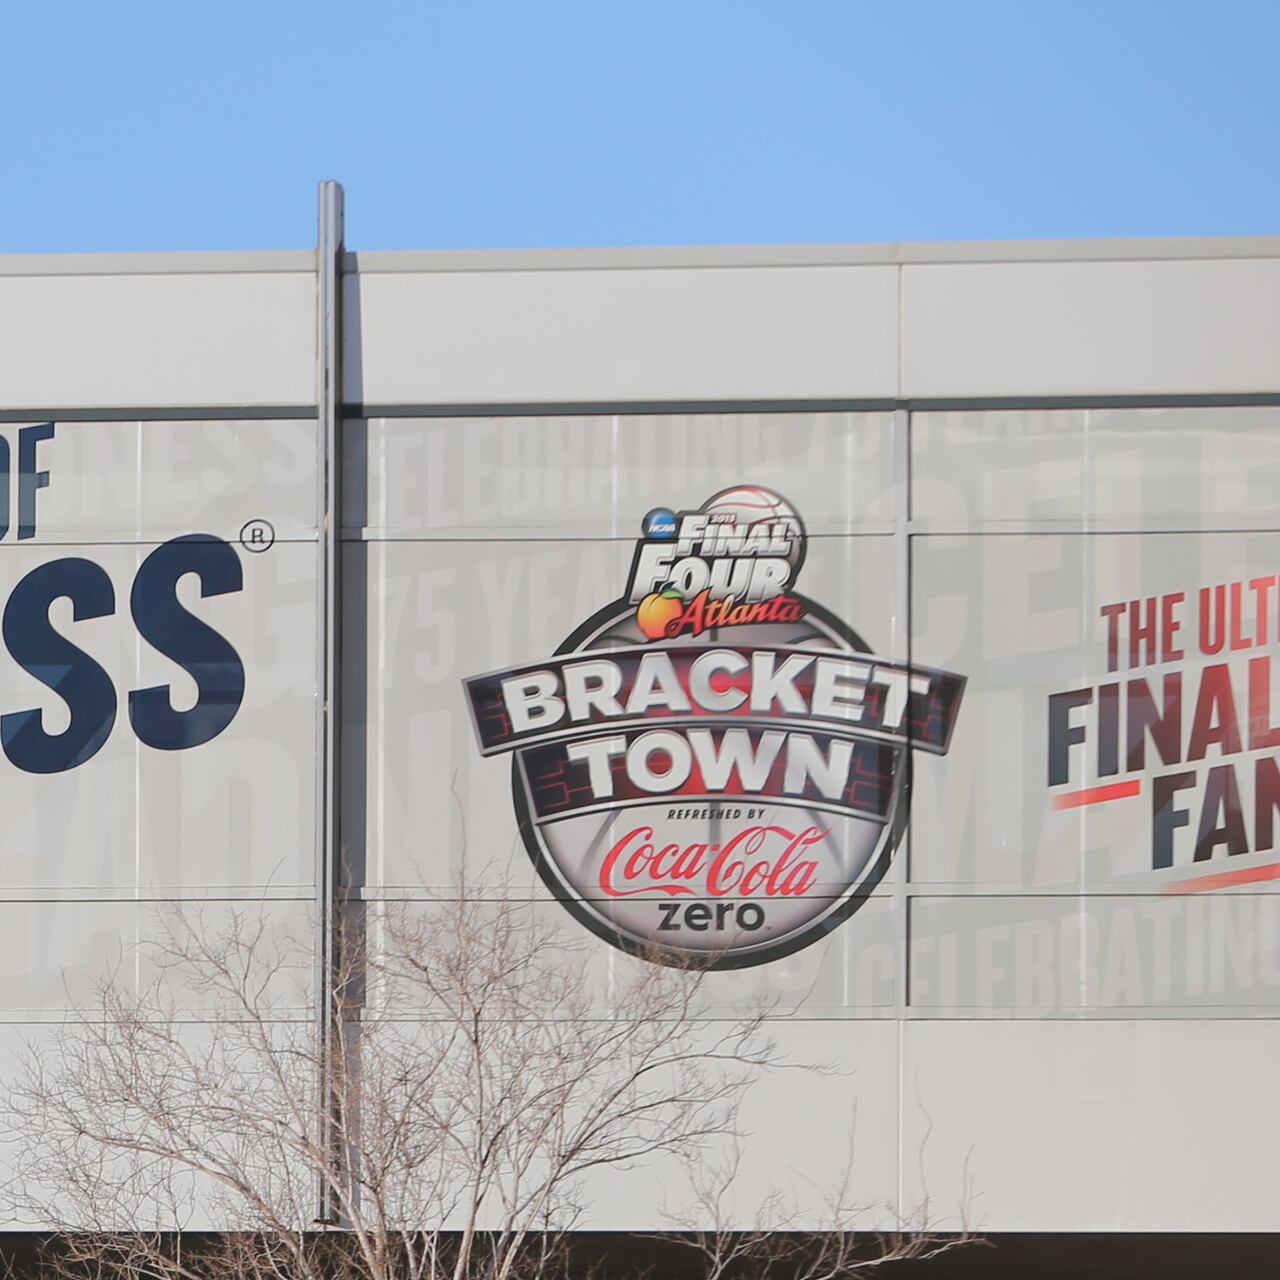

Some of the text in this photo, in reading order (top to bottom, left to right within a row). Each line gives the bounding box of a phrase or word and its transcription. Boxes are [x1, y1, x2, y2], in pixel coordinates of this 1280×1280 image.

[676, 514, 792, 556] FINAL
[631, 543, 792, 604] FOUR
[665, 588, 803, 637] Atlanta
[1100, 575, 1280, 673] THE ULT
[500, 648, 931, 734] BRACKET
[1048, 655, 1280, 787] FINAL
[567, 727, 856, 800] TOWN
[667, 806, 767, 822] REFRESHED BY
[598, 825, 832, 897] Coca-Cola
[657, 901, 767, 932] zero
